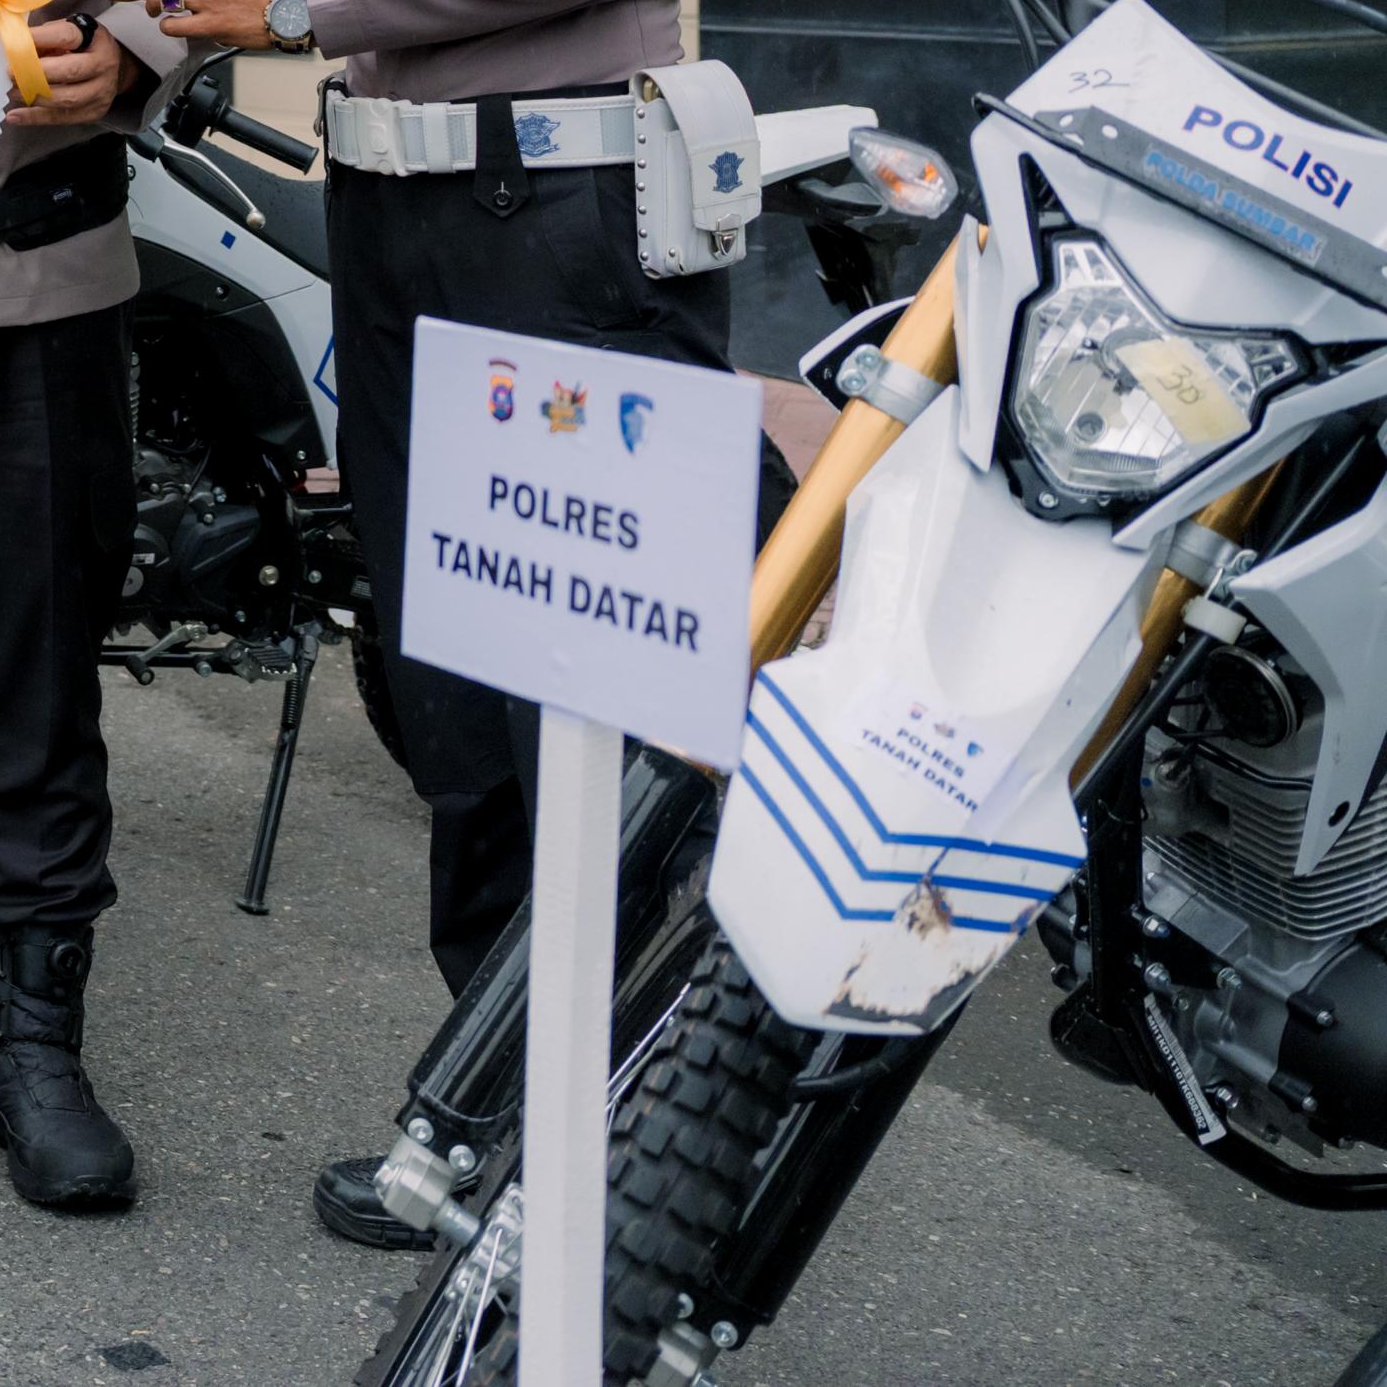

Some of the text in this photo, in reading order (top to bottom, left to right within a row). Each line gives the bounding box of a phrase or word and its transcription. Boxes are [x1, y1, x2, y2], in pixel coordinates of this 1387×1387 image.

[1067, 68, 1131, 94] 32
[1182, 105, 1353, 210] POLISI
[1146, 149, 1317, 252] POLDA SUMBAR
[488, 474, 641, 550] POLRES
[432, 532, 700, 652] TANAH DATAR
[861, 728, 978, 813] TANAH DATAR
[896, 727, 965, 778] POLRES
